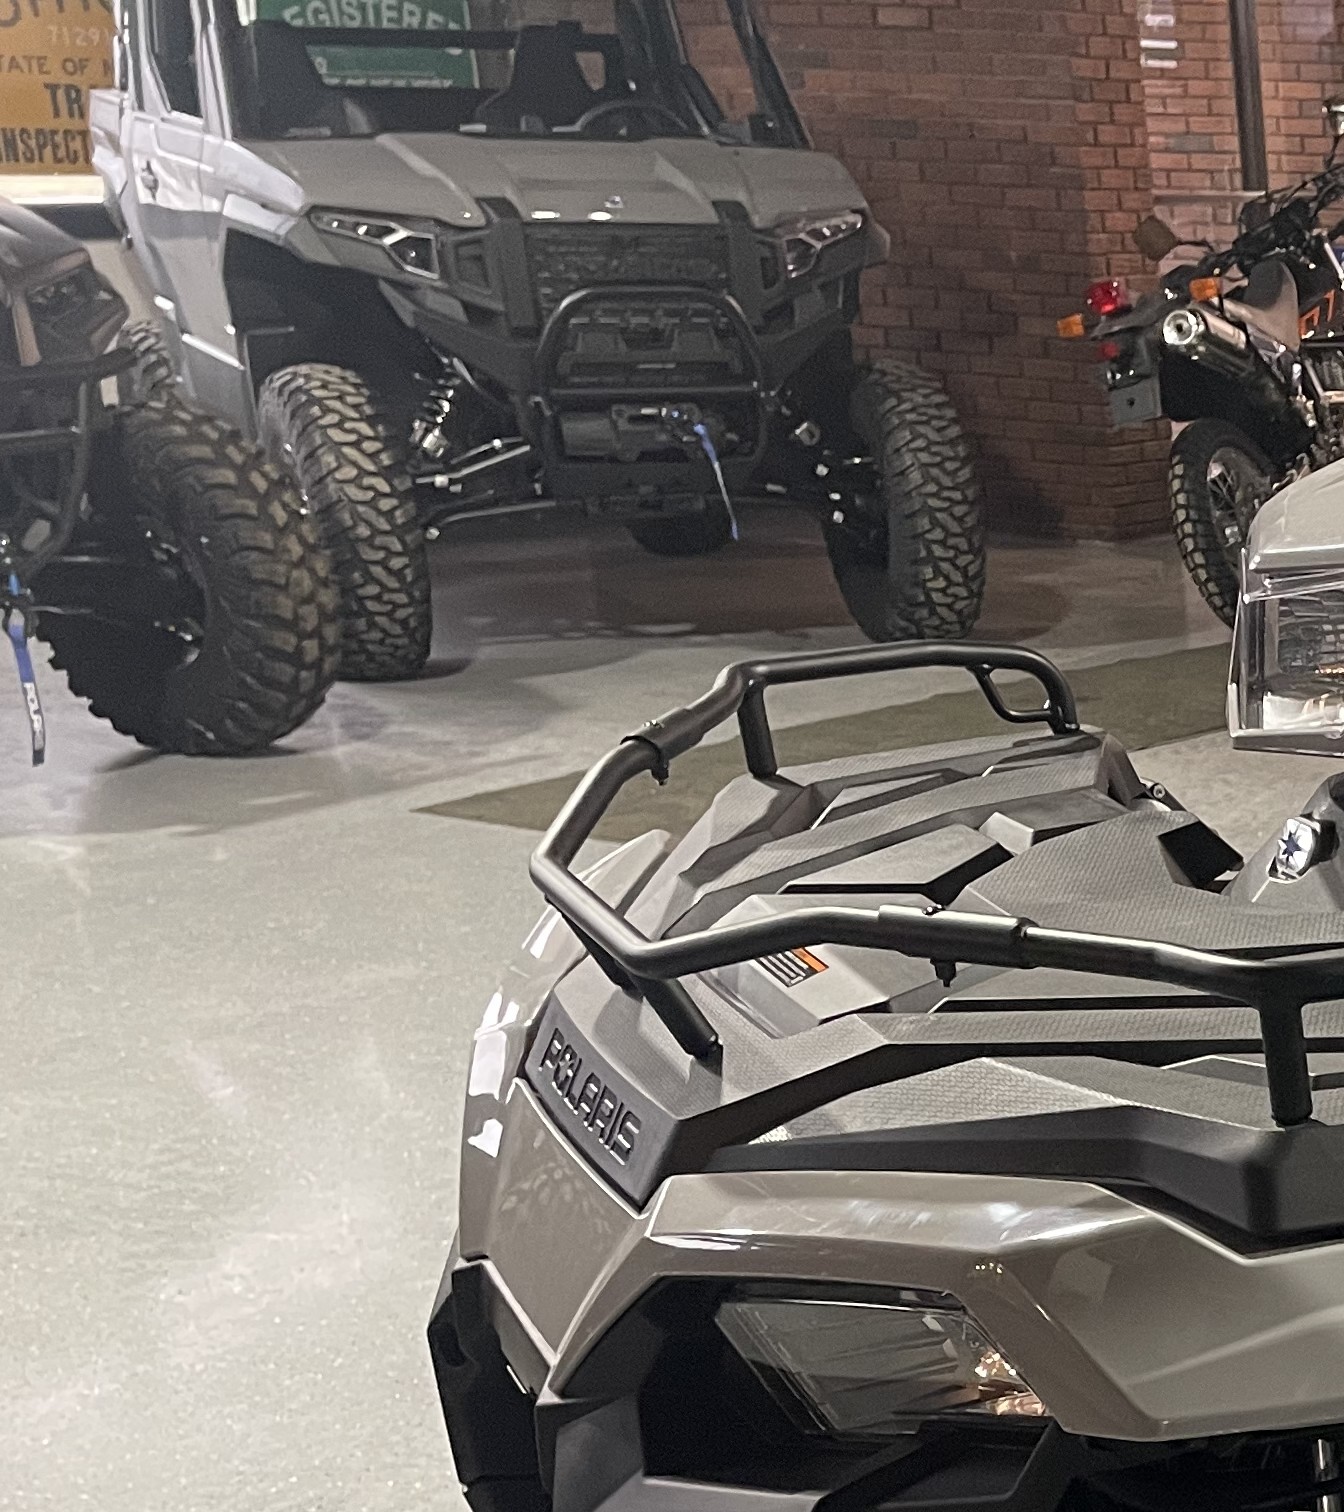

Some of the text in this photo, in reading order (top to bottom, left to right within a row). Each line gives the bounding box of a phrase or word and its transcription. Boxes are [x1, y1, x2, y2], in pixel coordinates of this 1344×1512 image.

[282, 0, 463, 29] EGISTERE
[62, 58, 90, 76] OF
[44, 83, 85, 119] TR
[0, 128, 92, 165] NSPECT
[539, 1027, 642, 1166] POLARIS
